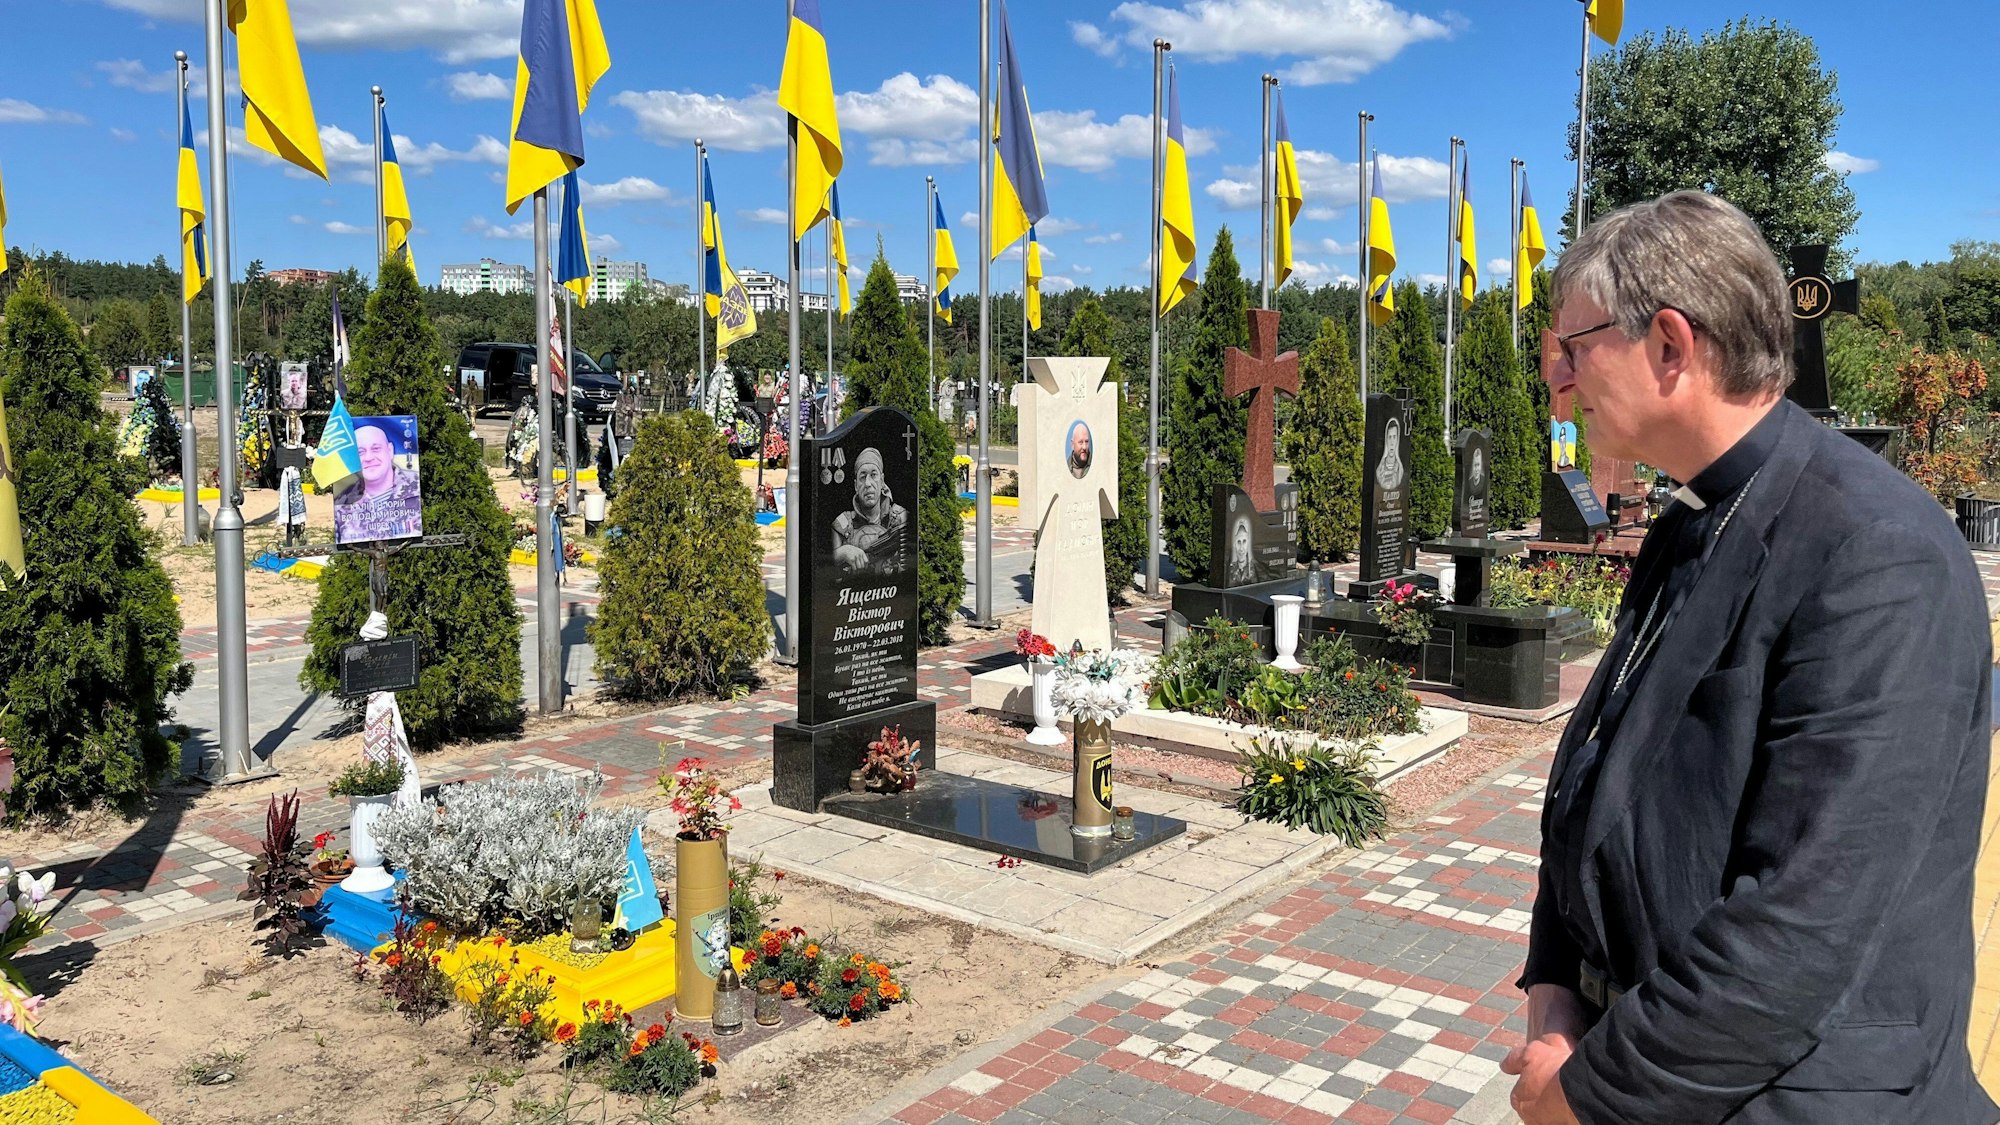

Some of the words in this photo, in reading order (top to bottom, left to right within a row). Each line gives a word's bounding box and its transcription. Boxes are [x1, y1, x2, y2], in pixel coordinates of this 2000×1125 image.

[836, 586, 897, 607] Ященко
[848, 606, 892, 623] Віктор
[833, 620, 905, 641] Вікторович
